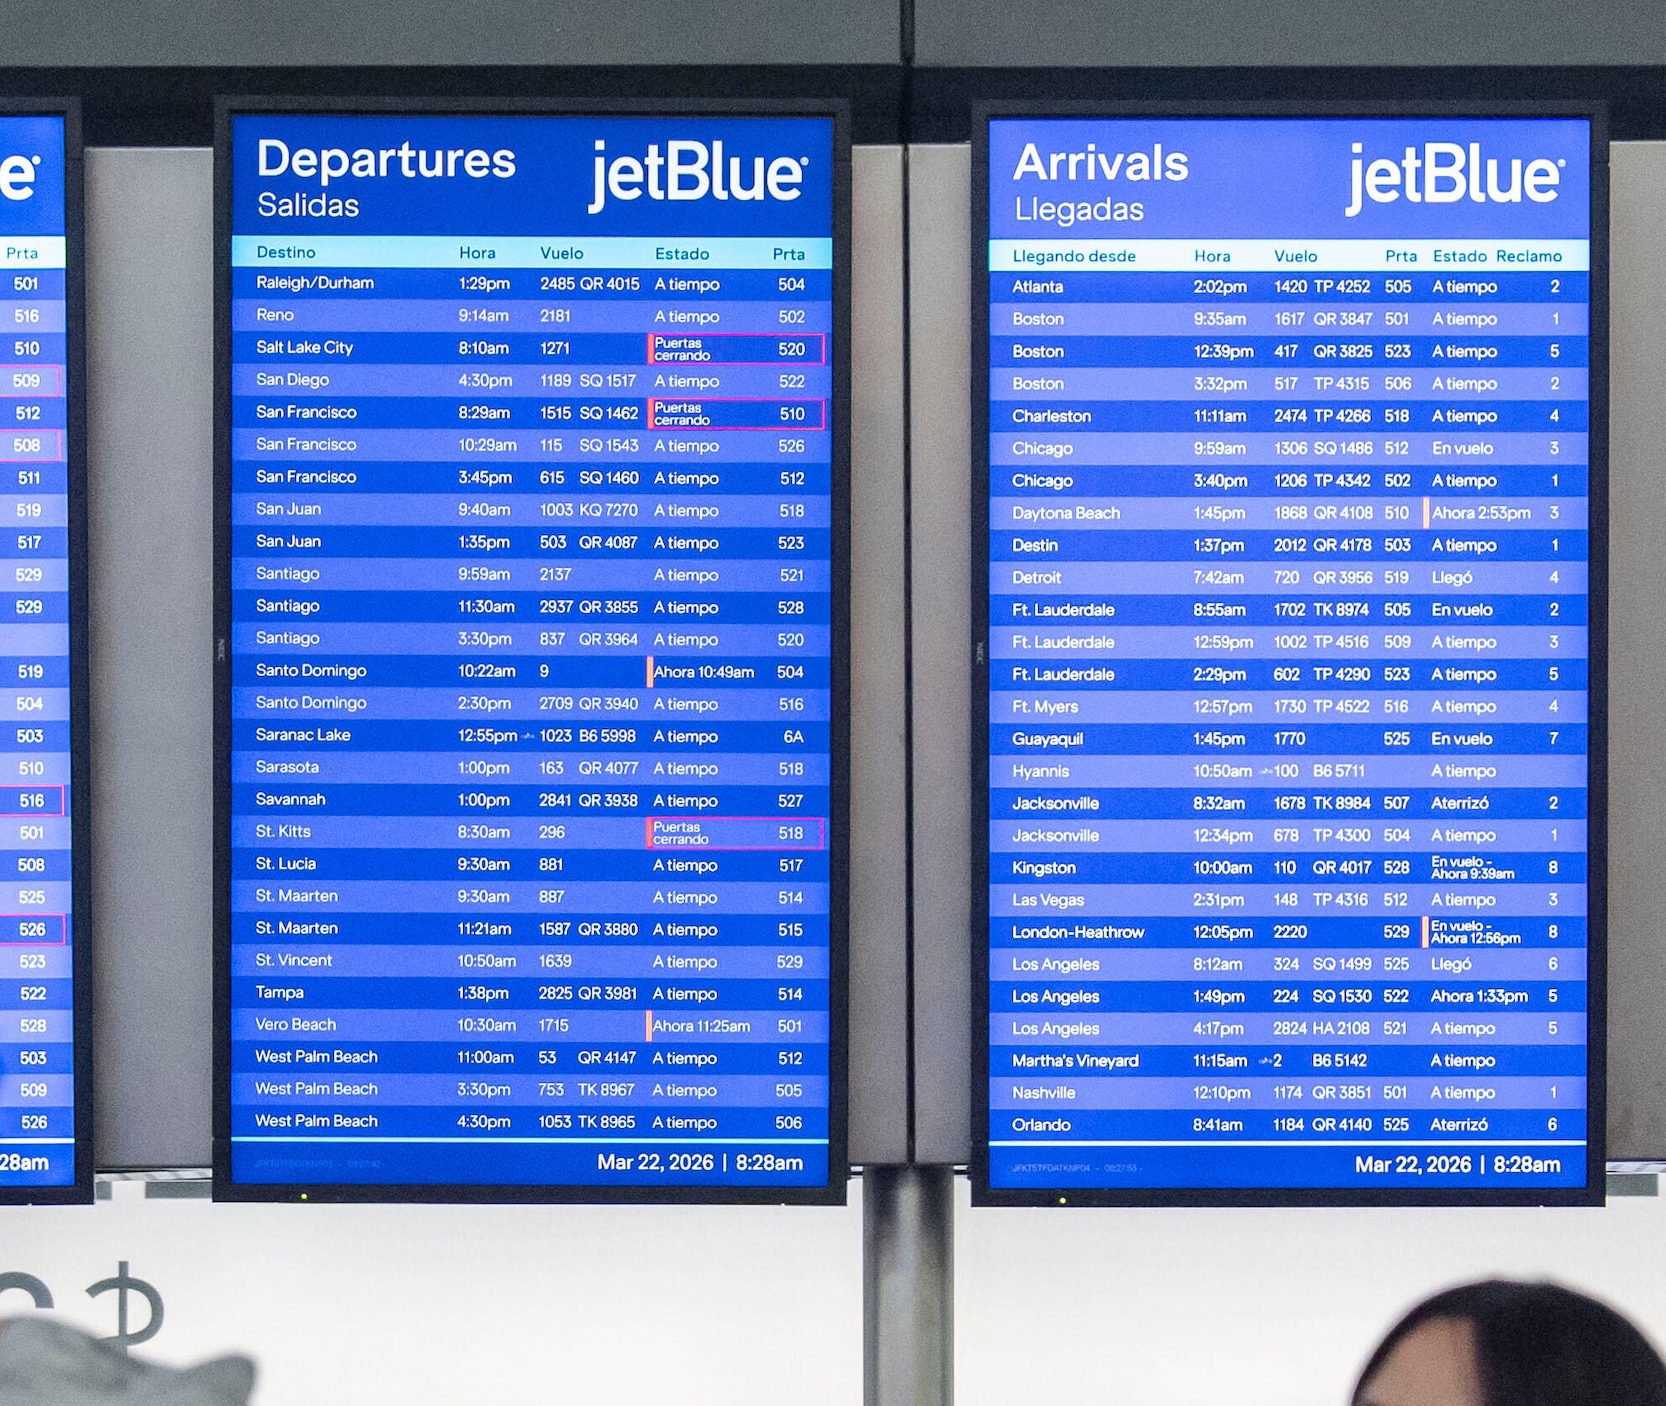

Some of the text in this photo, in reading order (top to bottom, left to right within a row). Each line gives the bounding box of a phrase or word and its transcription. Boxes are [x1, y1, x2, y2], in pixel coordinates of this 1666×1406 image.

[258, 138, 516, 187] Departures
[1012, 142, 1190, 182] Arrivals
[258, 191, 360, 218] Salidas
[1016, 196, 1144, 227] Llegadas
[1013, 249, 1563, 266] Llegando desde Hora Vuelo Prta Estado Reclamo
[14, 275, 38, 291] 501
[256, 275, 806, 294] Raleigh/Durham 1:29pm 2485 QR 4015 A tiempo 504
[1012, 407, 1560, 426] Charleston 11:11am 2474 TP 4266 518 A tiempo 4
[1012, 731, 1559, 749] Guayaquil 1:45pm 1770 525 En vuelo 7
[1355, 1155, 1561, 1176] Mar 22, 2026 8:28am
